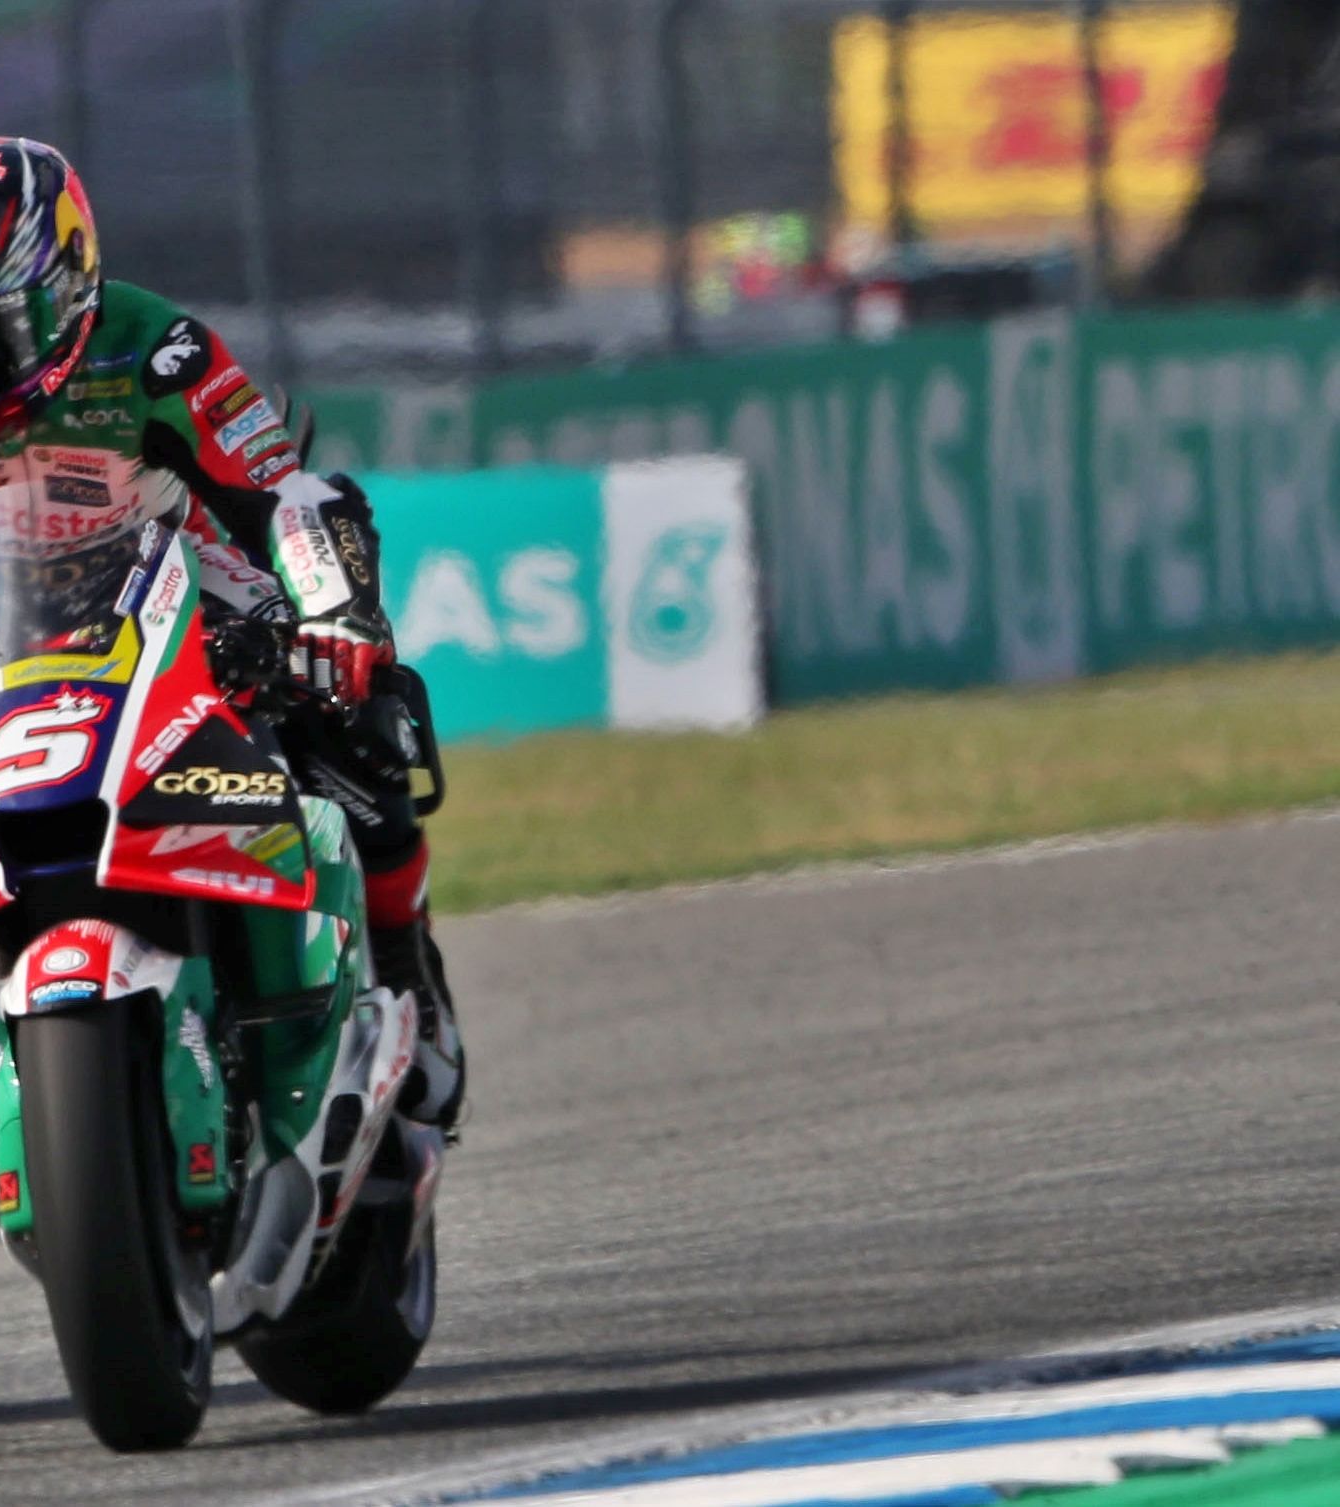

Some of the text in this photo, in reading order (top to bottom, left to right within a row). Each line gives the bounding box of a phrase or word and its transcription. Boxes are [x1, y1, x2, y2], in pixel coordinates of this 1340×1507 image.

[280, 506, 316, 578] Castrol
[151, 560, 185, 615] Castrol
[135, 693, 220, 777] SENA
[211, 793, 284, 808] SPORTS
[168, 866, 277, 897] GIVI
